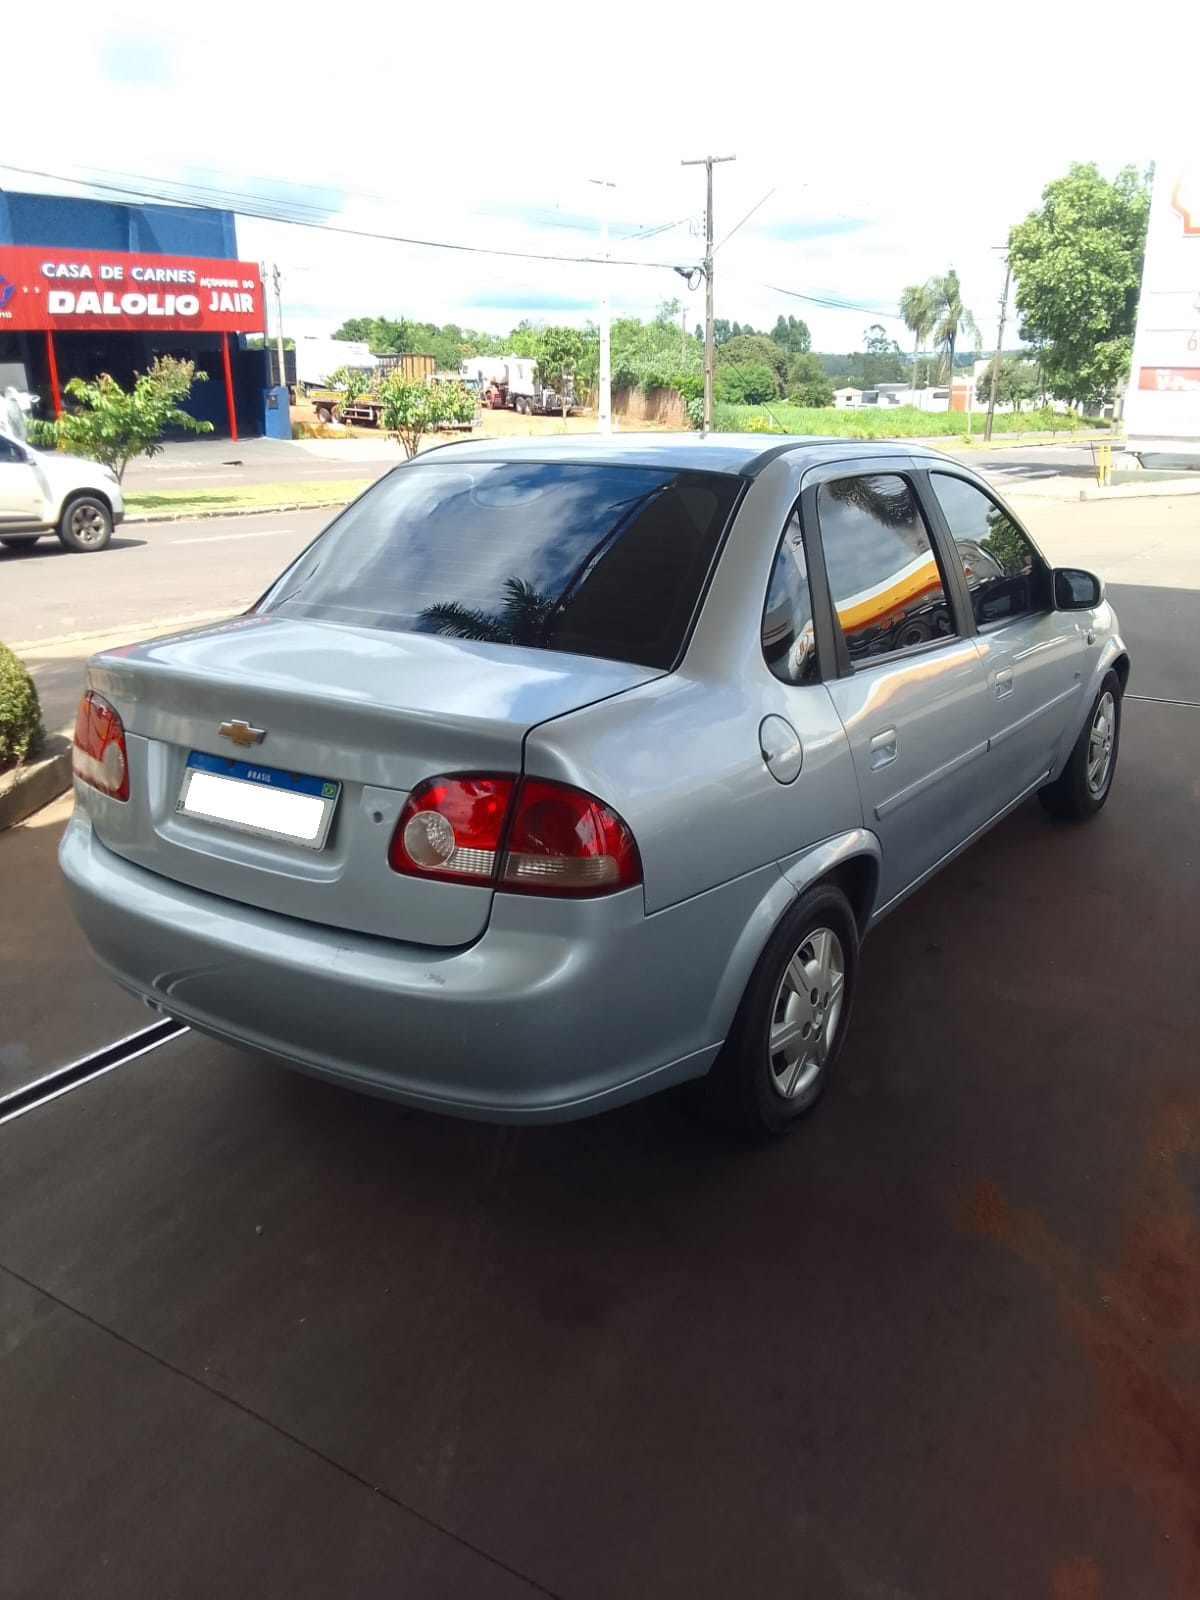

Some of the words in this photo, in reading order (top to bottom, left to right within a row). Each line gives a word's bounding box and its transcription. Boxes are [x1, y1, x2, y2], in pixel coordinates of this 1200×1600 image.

[41, 263, 92, 278] CASA
[100, 265, 123, 280] DE
[131, 267, 196, 283] CARNES
[242, 279, 255, 289] DO
[48, 291, 200, 316] DALOLIO
[208, 291, 255, 313] JAIR
[247, 770, 271, 782] BRASIL
